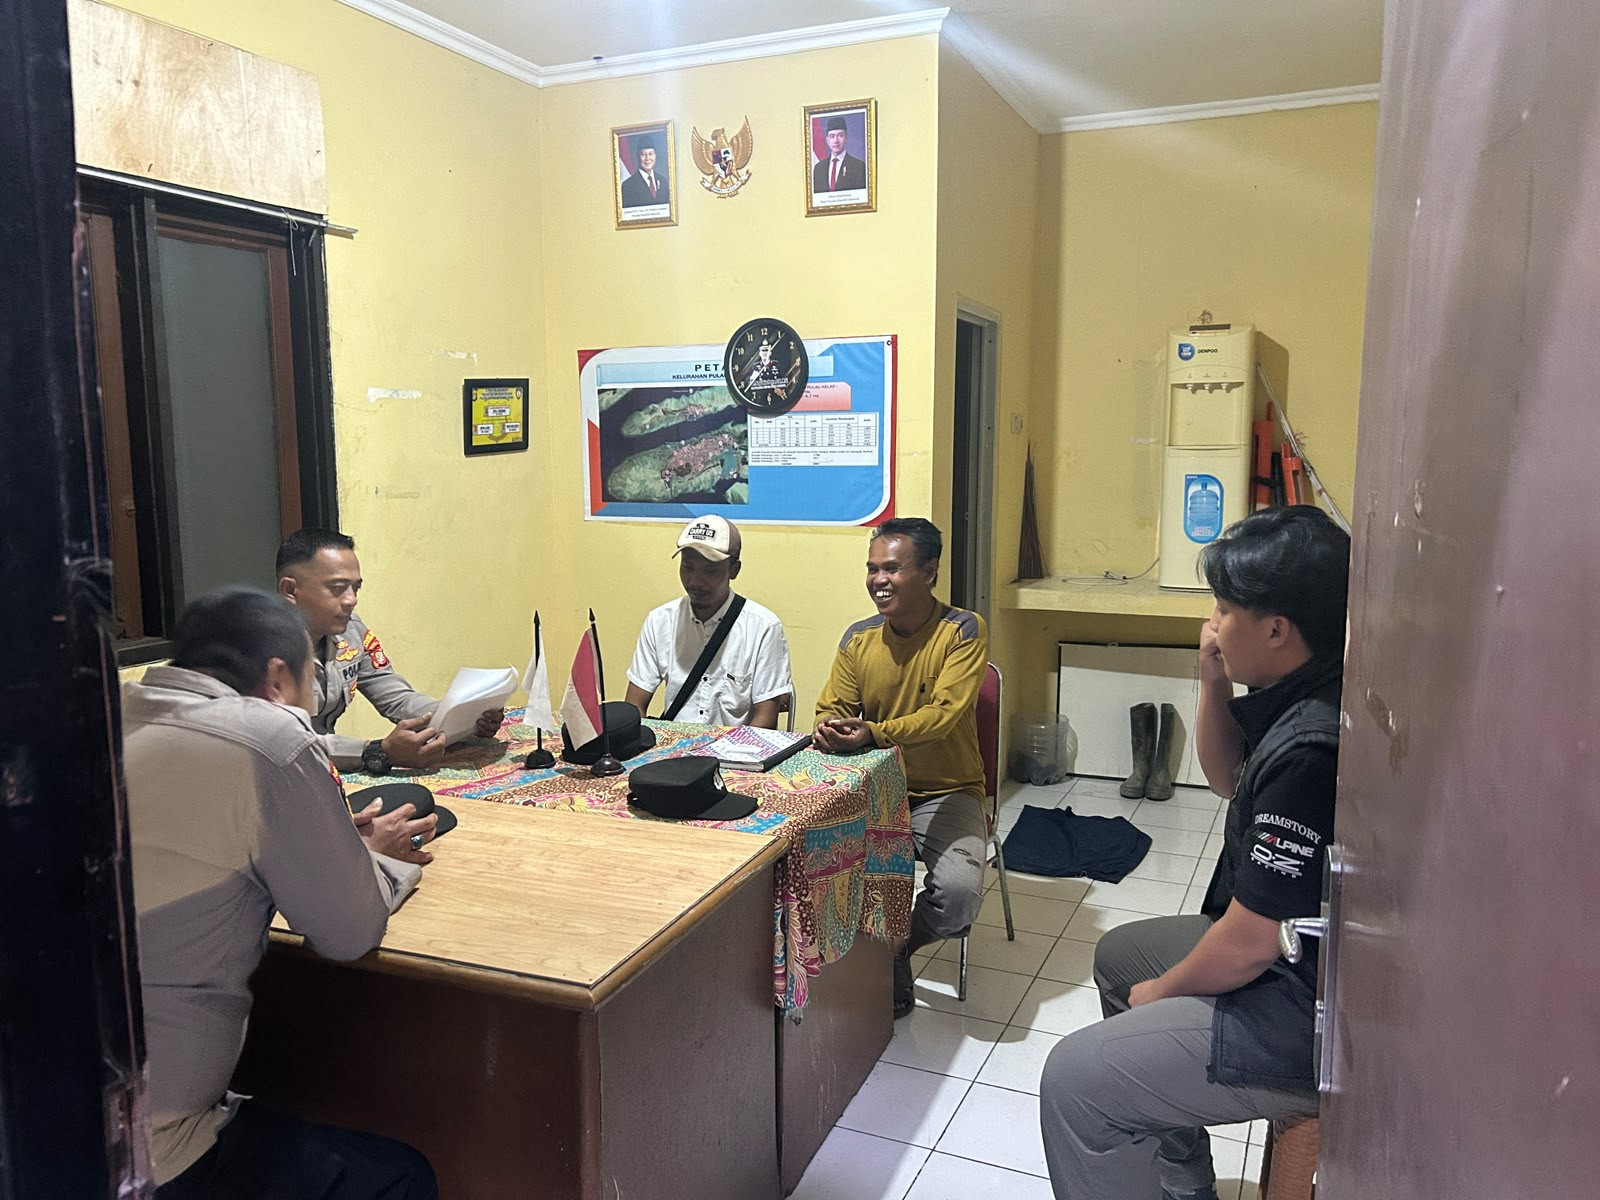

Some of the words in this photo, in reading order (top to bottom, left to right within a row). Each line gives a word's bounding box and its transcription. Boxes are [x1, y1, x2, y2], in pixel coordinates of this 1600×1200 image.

[761, 328, 768, 336] 12
[747, 333, 753, 342] 11
[789, 341, 794, 349] 2
[738, 347, 744, 355] 10
[735, 364, 739, 372] 9
[767, 393, 772, 402] 6
[1254, 813, 1322, 844] DREAMSTORY
[1265, 834, 1315, 858] ALPINE
